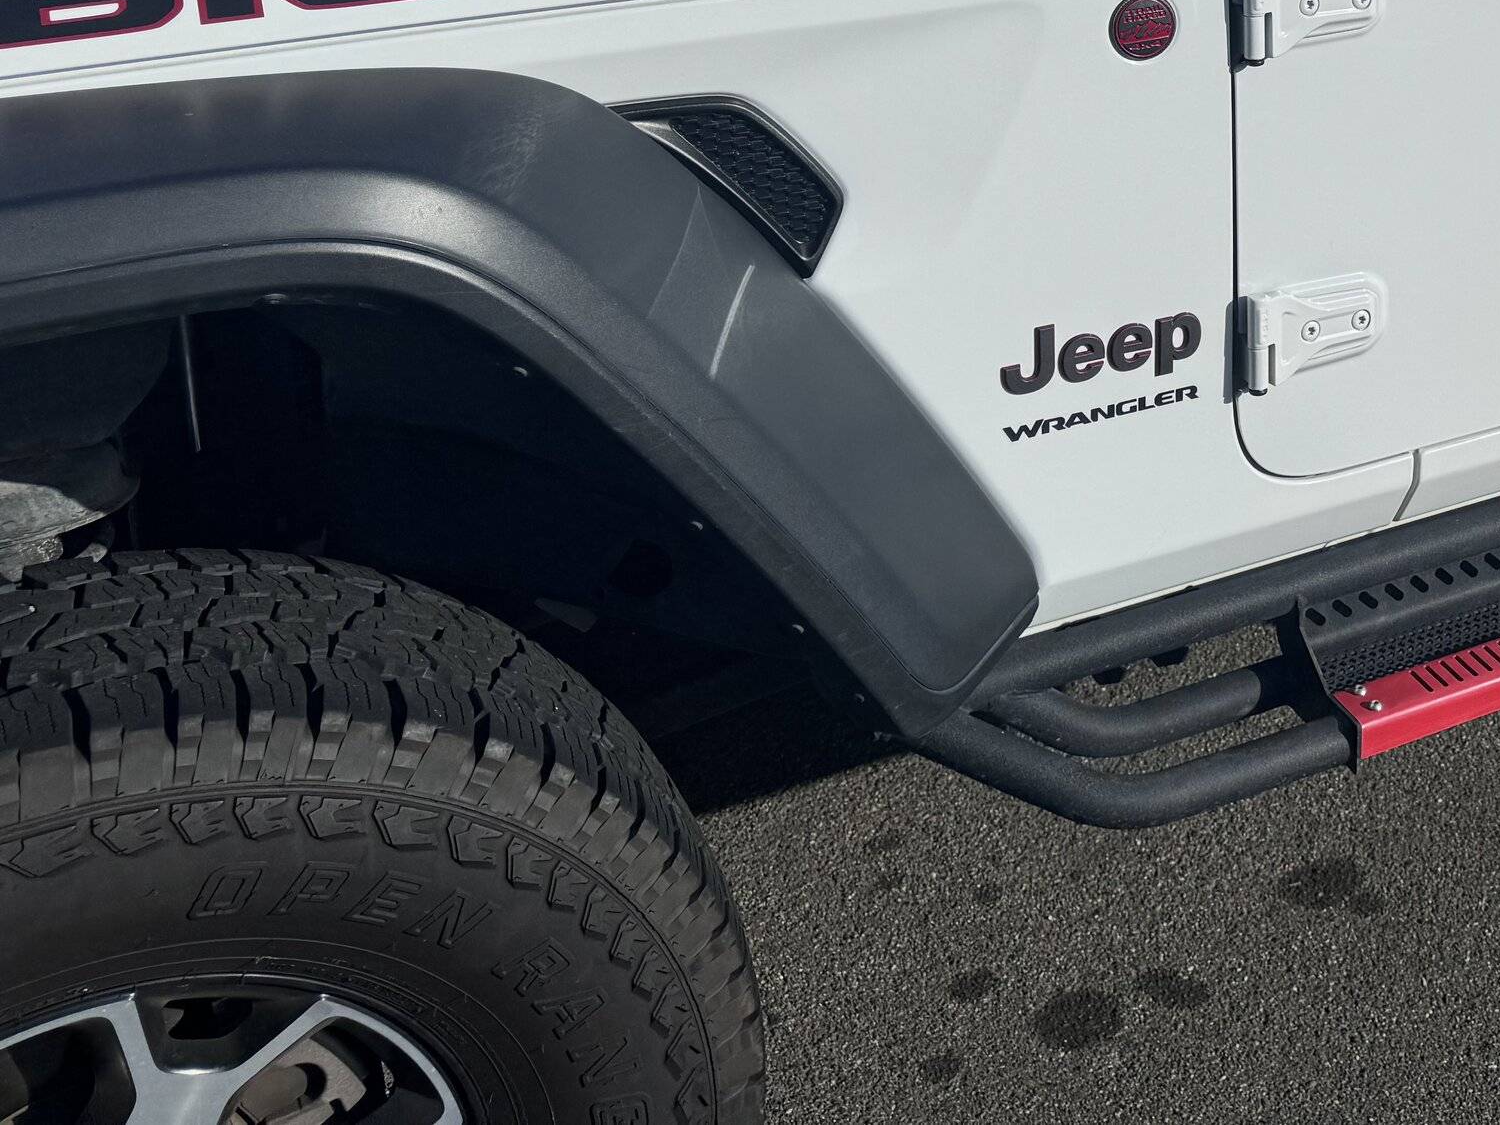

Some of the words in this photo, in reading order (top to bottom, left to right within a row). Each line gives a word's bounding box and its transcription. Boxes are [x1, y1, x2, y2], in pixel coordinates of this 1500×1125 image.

[1000, 312, 1202, 395] Jeep
[1002, 385, 1200, 443] WRANGLER
[186, 860, 496, 950] OPEN
